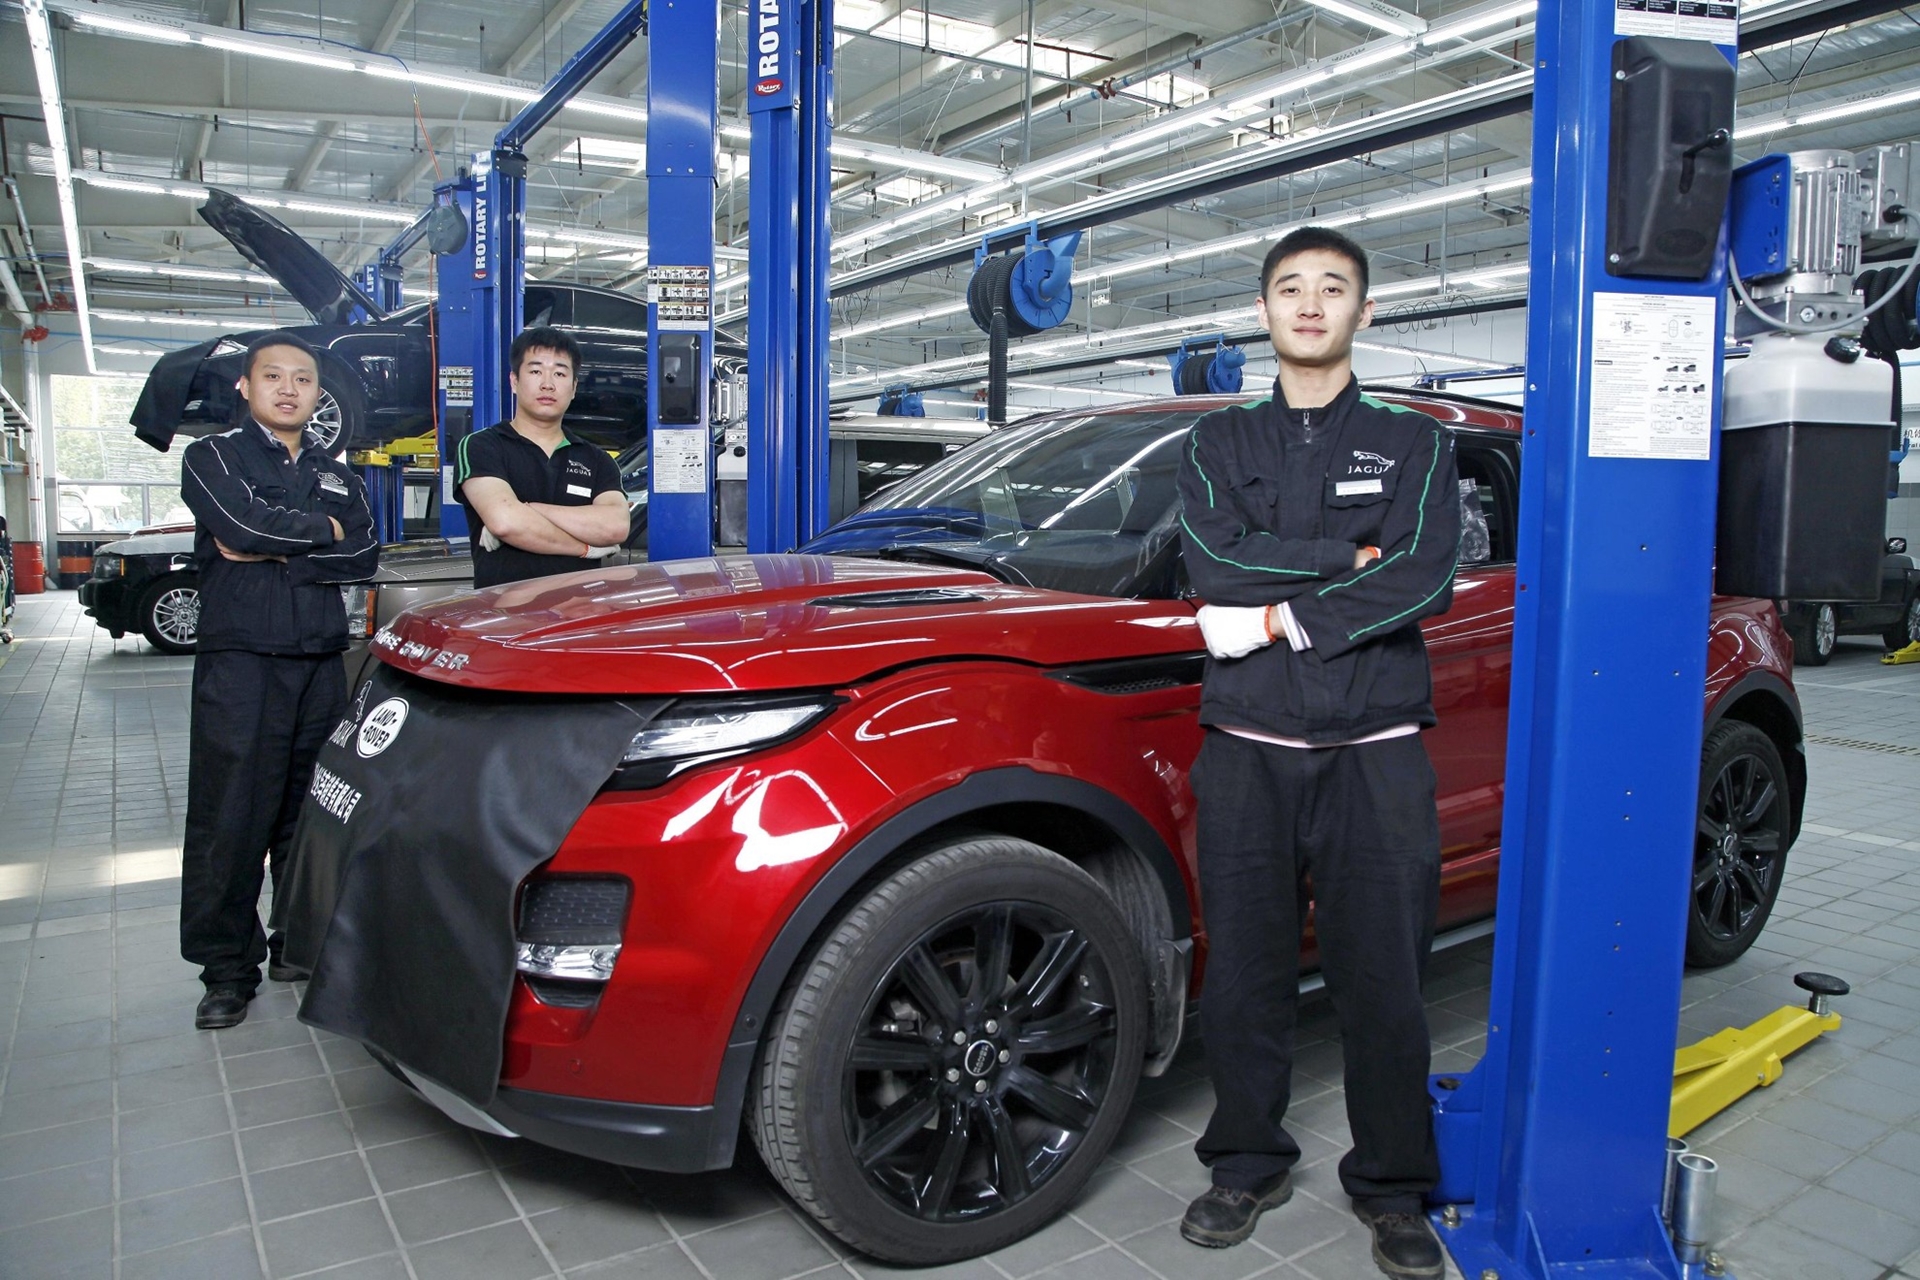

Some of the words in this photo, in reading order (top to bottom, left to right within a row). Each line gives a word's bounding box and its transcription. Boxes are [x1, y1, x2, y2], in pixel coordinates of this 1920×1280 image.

[475, 197, 487, 269] ROTARY
[399, 640, 470, 670] ROVER
[372, 707, 397, 727] LAND
[365, 725, 391, 749] ROVER
